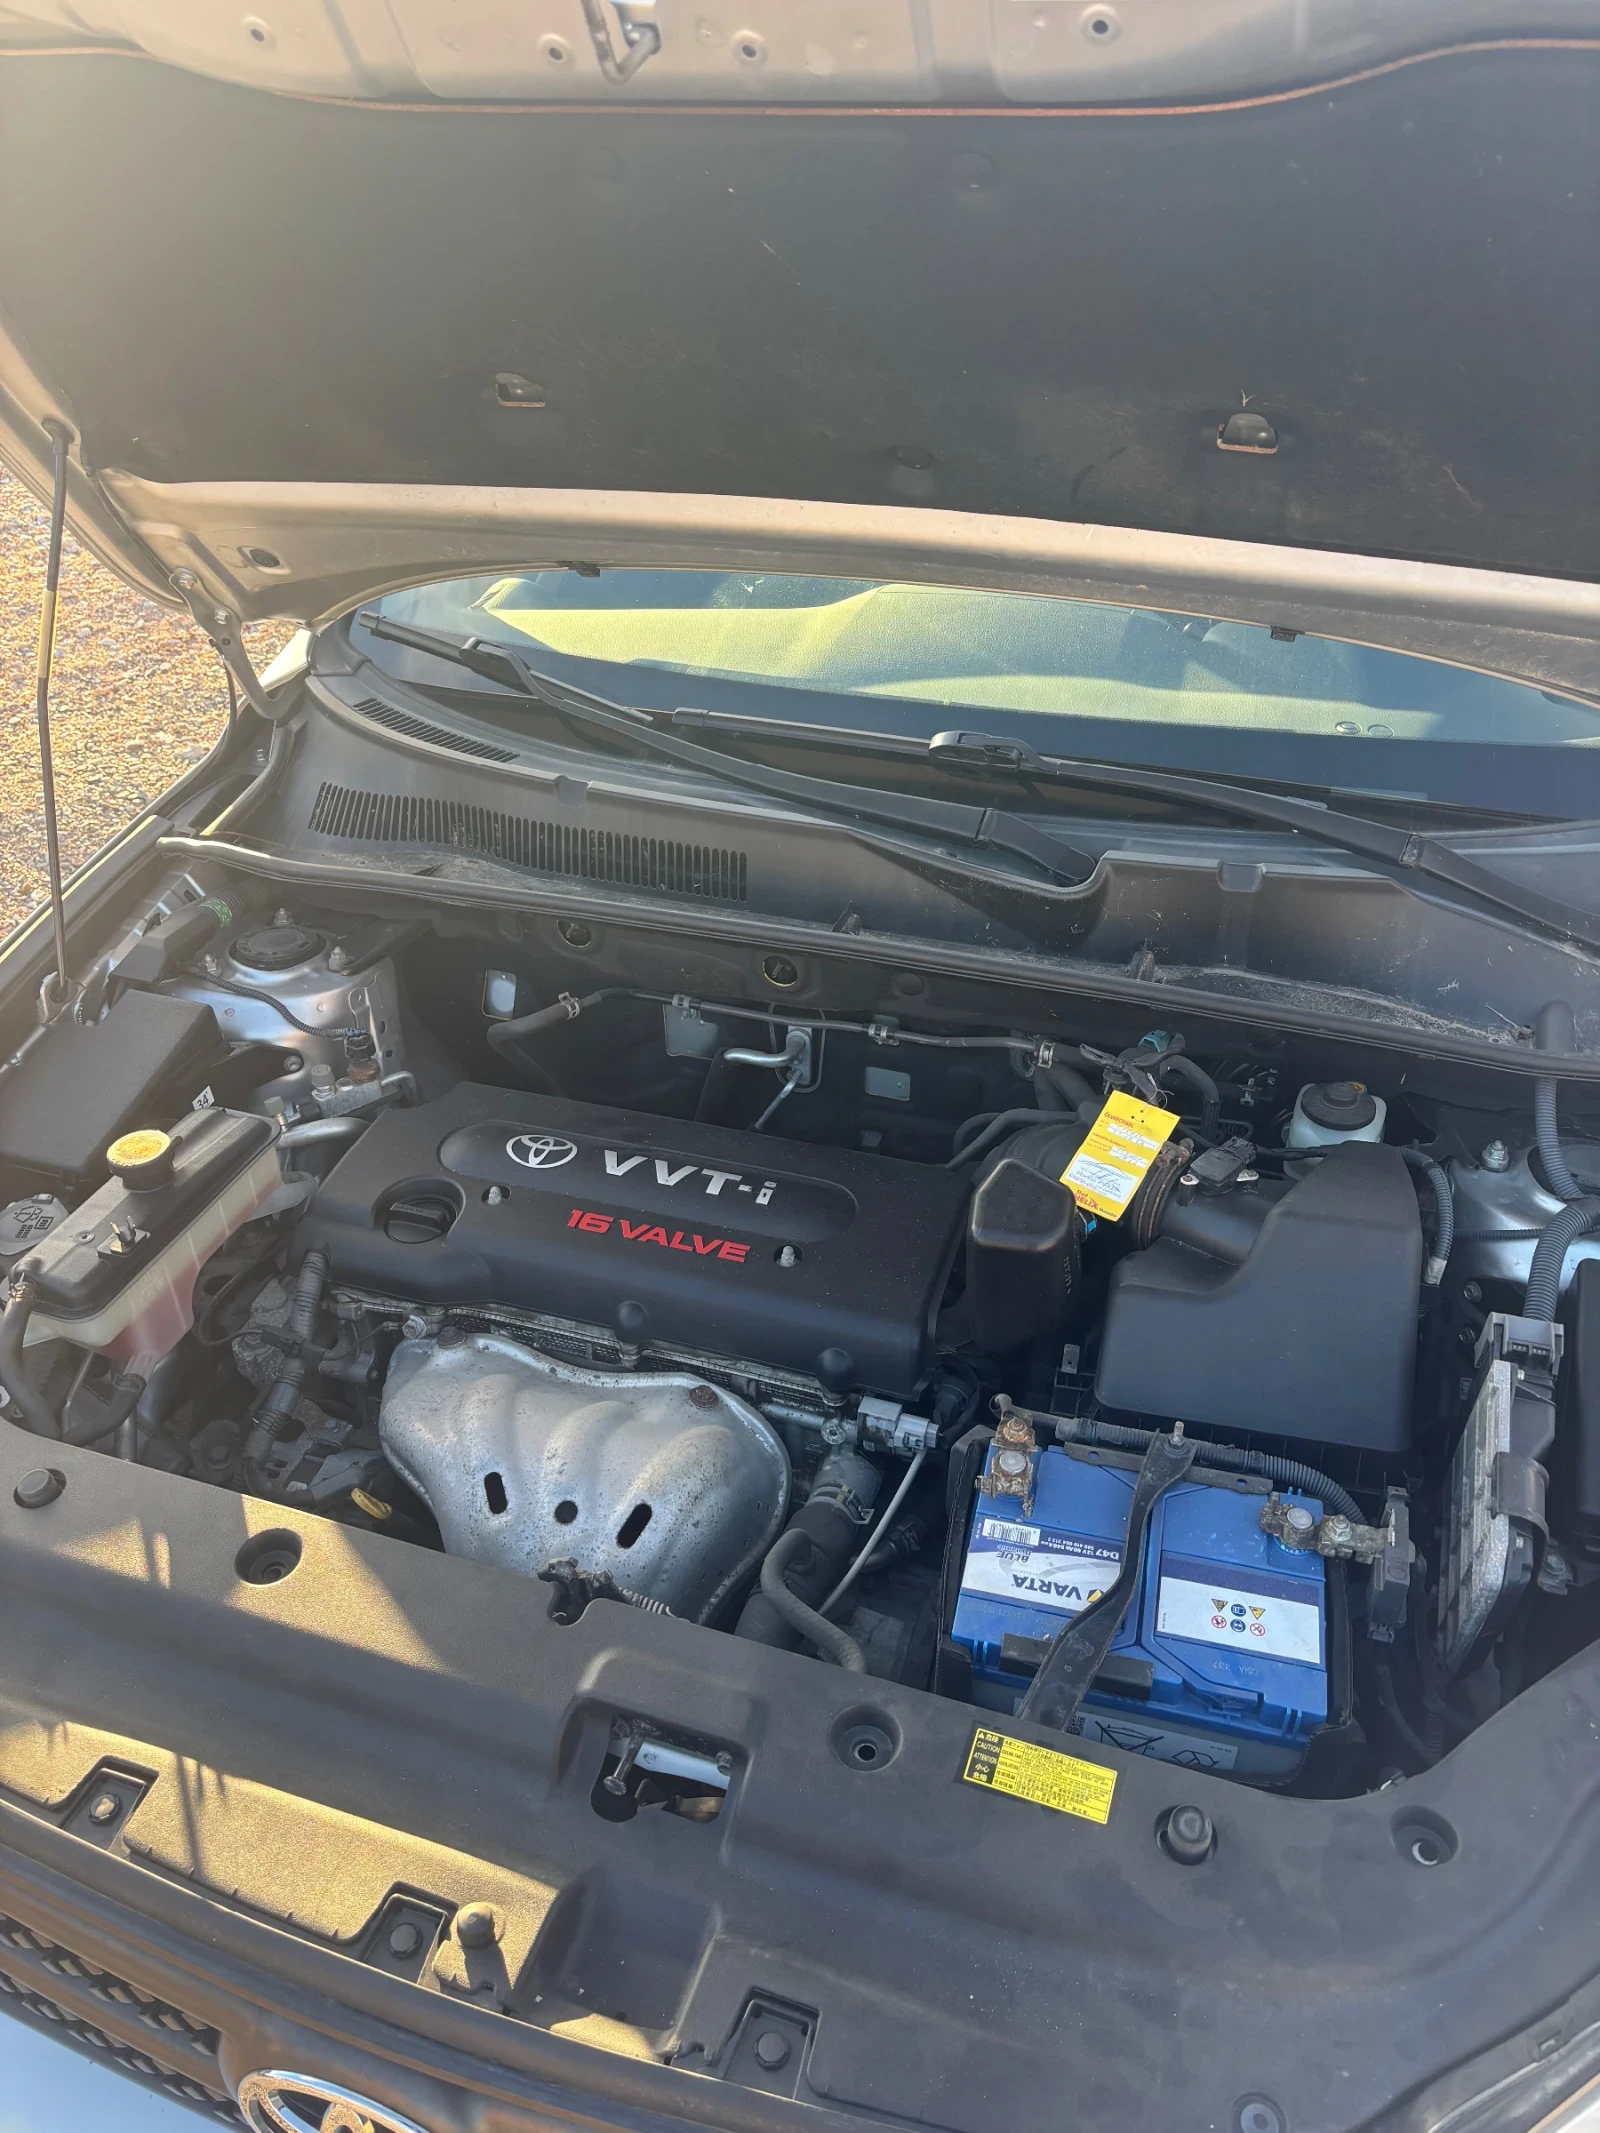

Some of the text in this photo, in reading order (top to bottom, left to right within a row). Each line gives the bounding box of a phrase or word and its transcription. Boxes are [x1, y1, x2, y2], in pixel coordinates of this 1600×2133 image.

[604, 1150, 777, 1206] VVT-i
[567, 1209, 751, 1263] 16 VALVE
[1065, 1545, 1081, 1553] 60Ah
[1096, 1548, 1119, 1560] D47
[997, 1551, 1030, 1563] BLUE
[1012, 1574, 1082, 1601] VARTA
[977, 1741, 1000, 1753] CAUTION
[973, 1752, 997, 1764] ATTENTION
